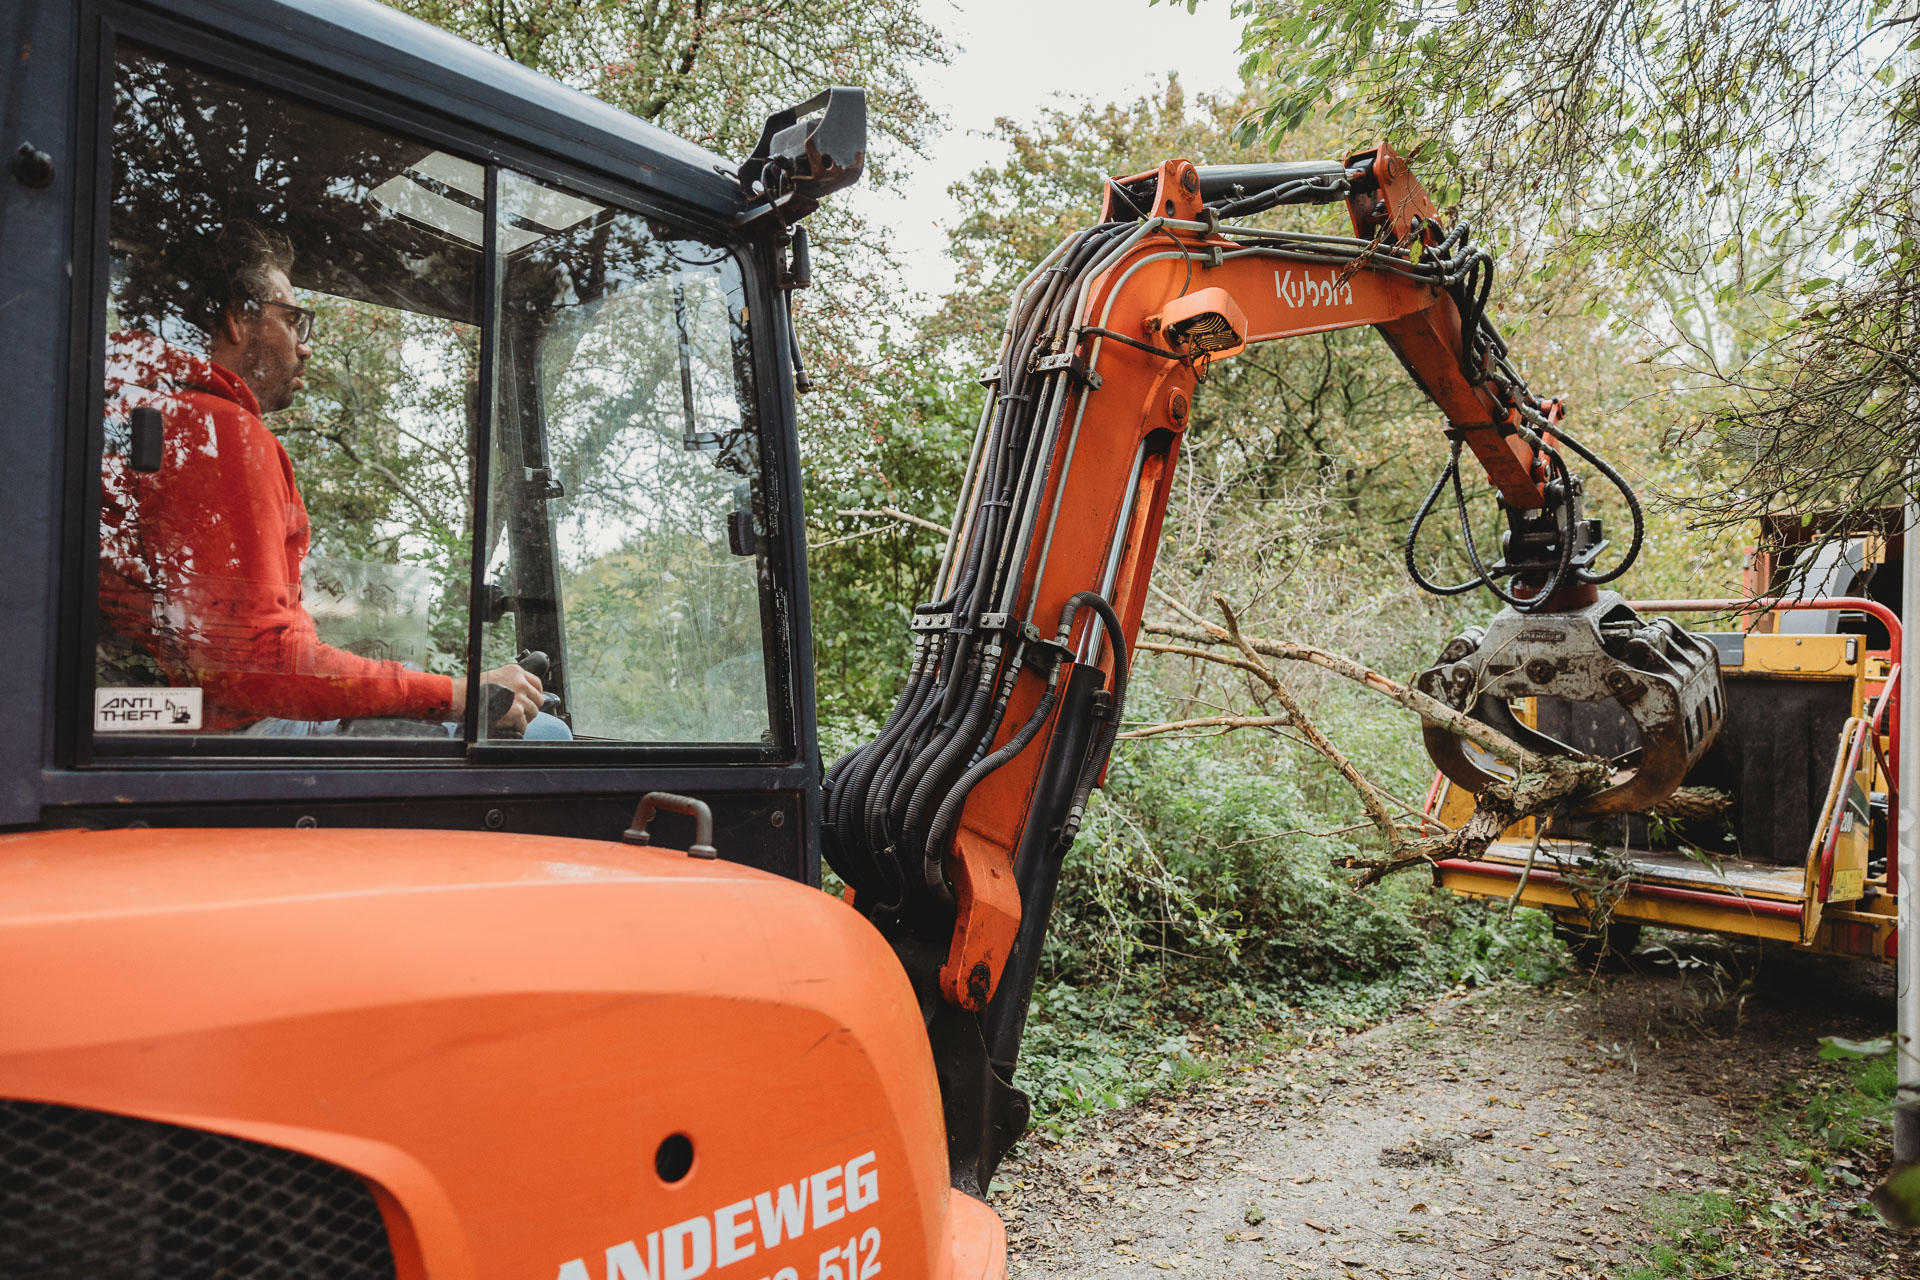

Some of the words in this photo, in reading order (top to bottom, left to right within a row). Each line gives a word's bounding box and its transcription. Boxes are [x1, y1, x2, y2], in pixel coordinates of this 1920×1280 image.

[1274, 270, 1353, 308] Kubota
[100, 709, 163, 721] THEFT
[101, 697, 153, 709] ANTI
[818, 1227, 881, 1280] 512
